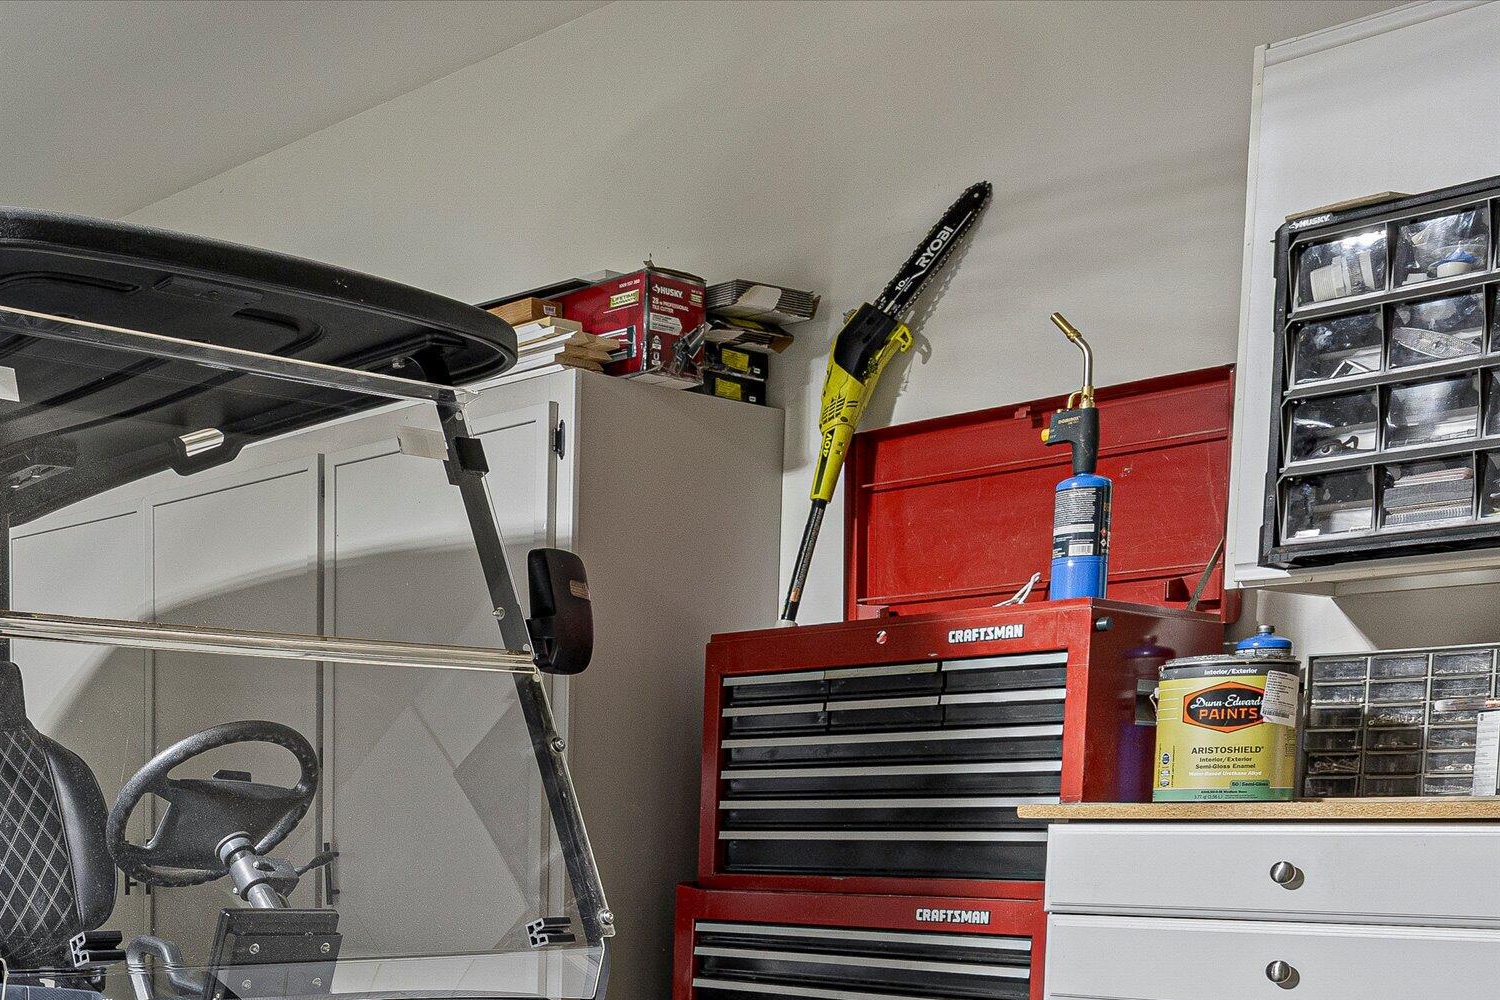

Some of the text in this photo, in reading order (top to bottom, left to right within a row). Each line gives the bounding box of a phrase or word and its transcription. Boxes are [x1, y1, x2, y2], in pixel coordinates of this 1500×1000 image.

[915, 226, 954, 267] RYOBI
[660, 286, 683, 299] HUSKY
[823, 433, 833, 458] 40V
[948, 624, 1024, 644] CRAFTSMAN
[1203, 668, 1258, 676] Interior/Exterior
[1199, 707, 1258, 720] PAINTS
[915, 908, 990, 924] CRAFTSMAN
